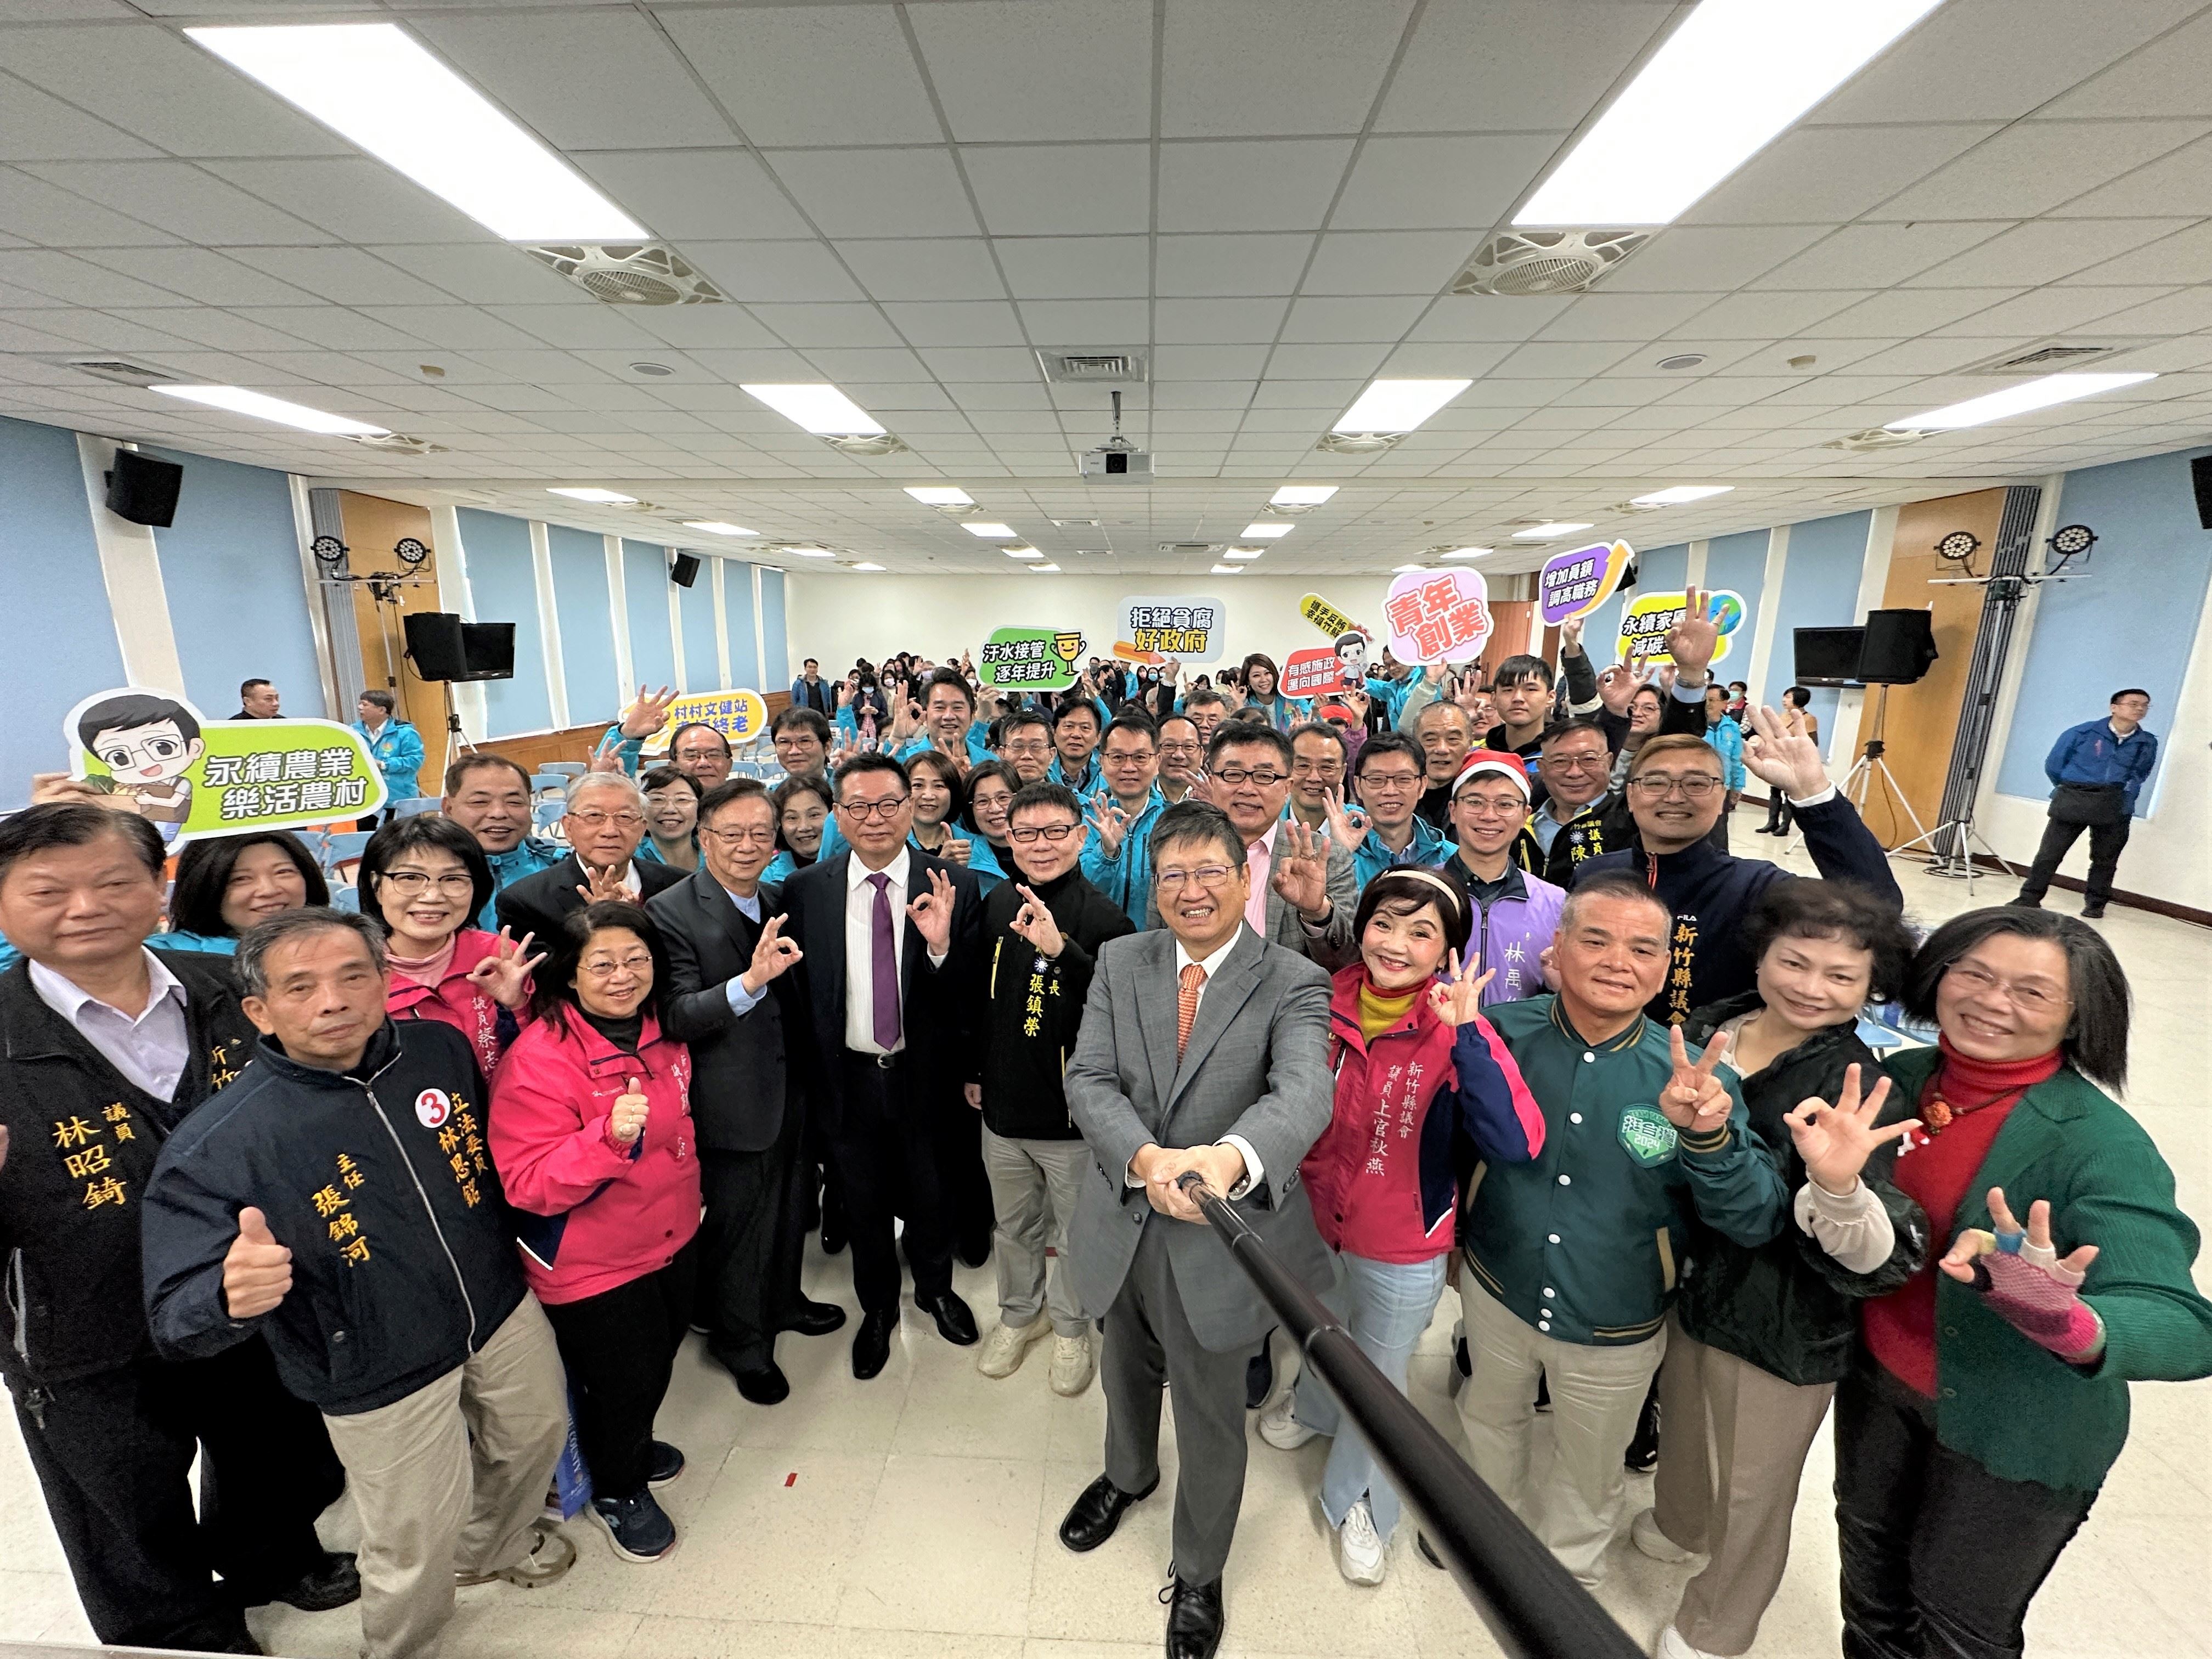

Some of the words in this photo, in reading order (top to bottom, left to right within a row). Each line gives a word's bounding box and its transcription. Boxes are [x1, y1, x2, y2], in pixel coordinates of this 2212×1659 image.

[1544, 558, 1595, 588] 增加員額
[1130, 607, 1213, 629] 拒絕貪腐
[1387, 574, 1462, 637] 青年
[1135, 628, 1207, 652] 好政府
[1413, 599, 1488, 661] 創業
[983, 640, 1046, 663] 汗水接管
[1632, 635, 1670, 657] 減碳
[994, 661, 1056, 683] 逐年提升
[1287, 670, 1334, 692] 邁向國際
[1288, 657, 1335, 677] 有感施政
[674, 698, 748, 720] 村村文健站
[204, 747, 354, 788] 永續農業
[221, 778, 368, 820] 樂活農村
[1571, 844, 1589, 870] 陳
[1588, 828, 1604, 855] 議員
[1504, 941, 1525, 1002] 林禹
[1024, 974, 1045, 1037] 張鎮榮
[421, 1092, 446, 1124] 3
[1397, 1060, 1424, 1139] 新竹縣議會
[101, 1102, 136, 1143] 議員
[1634, 1133, 1660, 1151] 2024
[53, 1115, 127, 1210] 林昭錡
[336, 1153, 365, 1190] 主任
[312, 1184, 371, 1267] 張錦河
